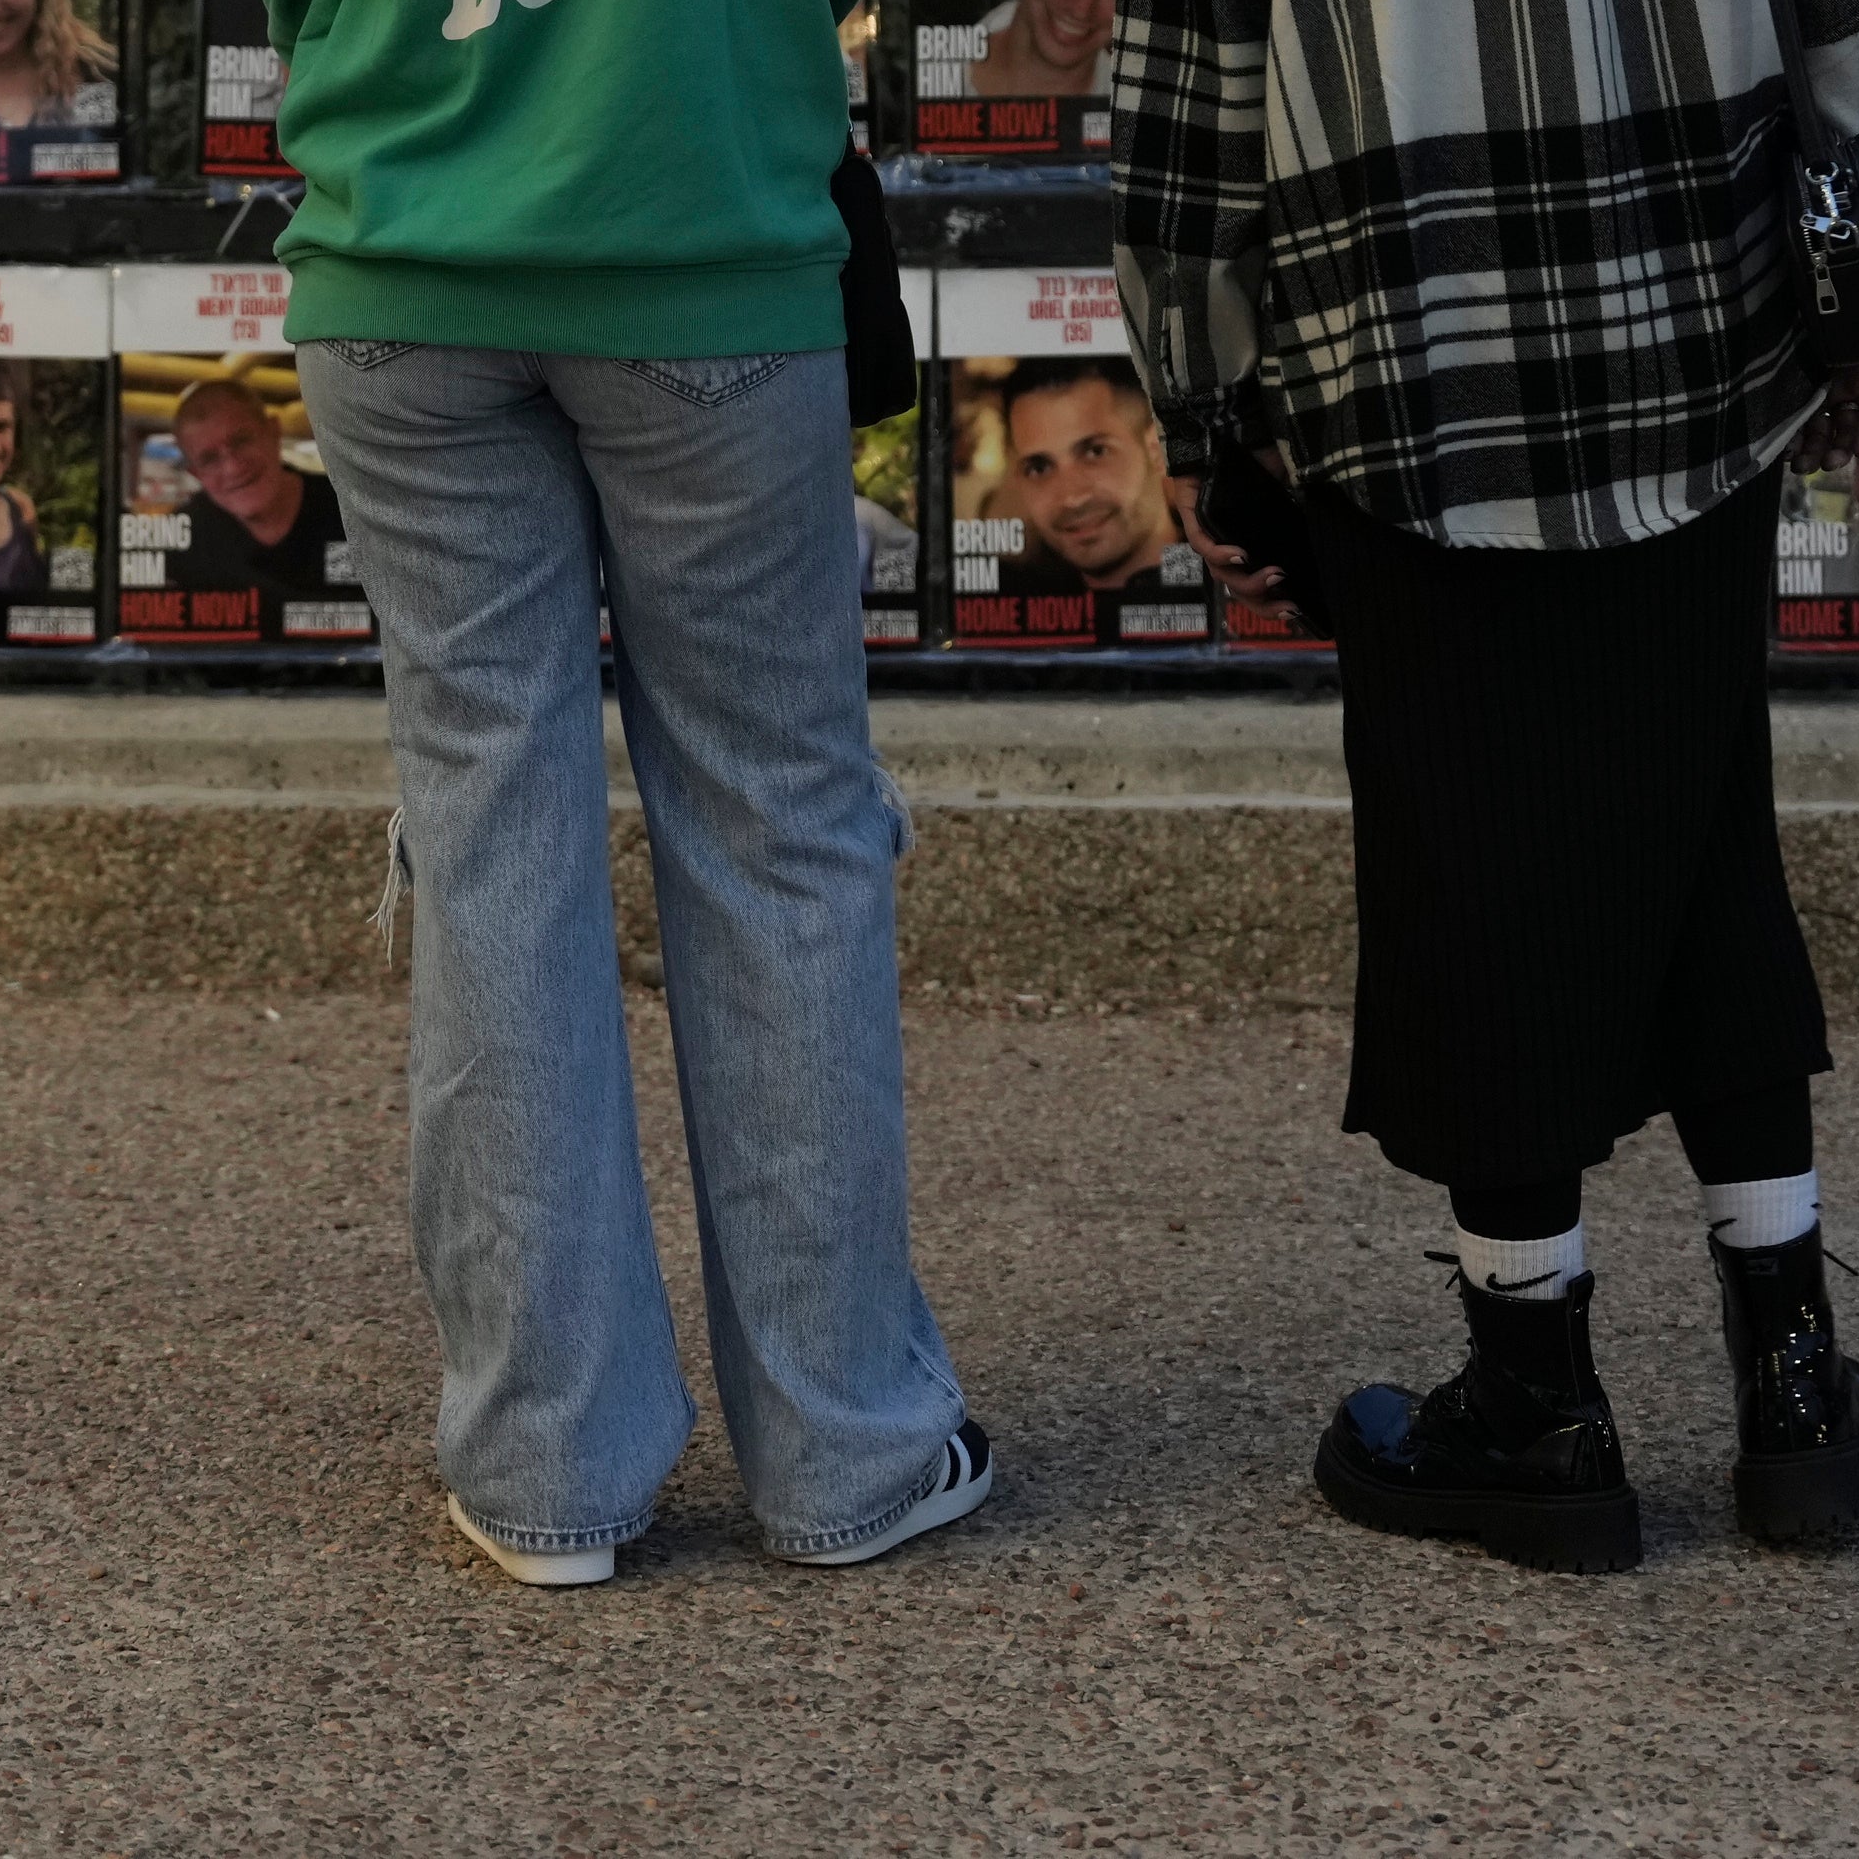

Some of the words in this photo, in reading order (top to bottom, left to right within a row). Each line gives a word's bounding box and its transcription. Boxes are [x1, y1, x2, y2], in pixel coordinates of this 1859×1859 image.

[916, 25, 988, 58] BRING
[917, 62, 963, 97] HIM
[918, 104, 983, 138] HOME
[990, 99, 1058, 134] NOW!
[1030, 300, 1066, 319] URIEL
[1064, 322, 1092, 344] (35)
[954, 518, 1024, 555] BRING
[1778, 522, 1847, 556] BRING
[954, 555, 998, 591] HIM
[1779, 558, 1822, 594] HIM
[954, 598, 1019, 631] HOME
[1028, 592, 1094, 630] NOW!
[1779, 601, 1845, 635] HOME
